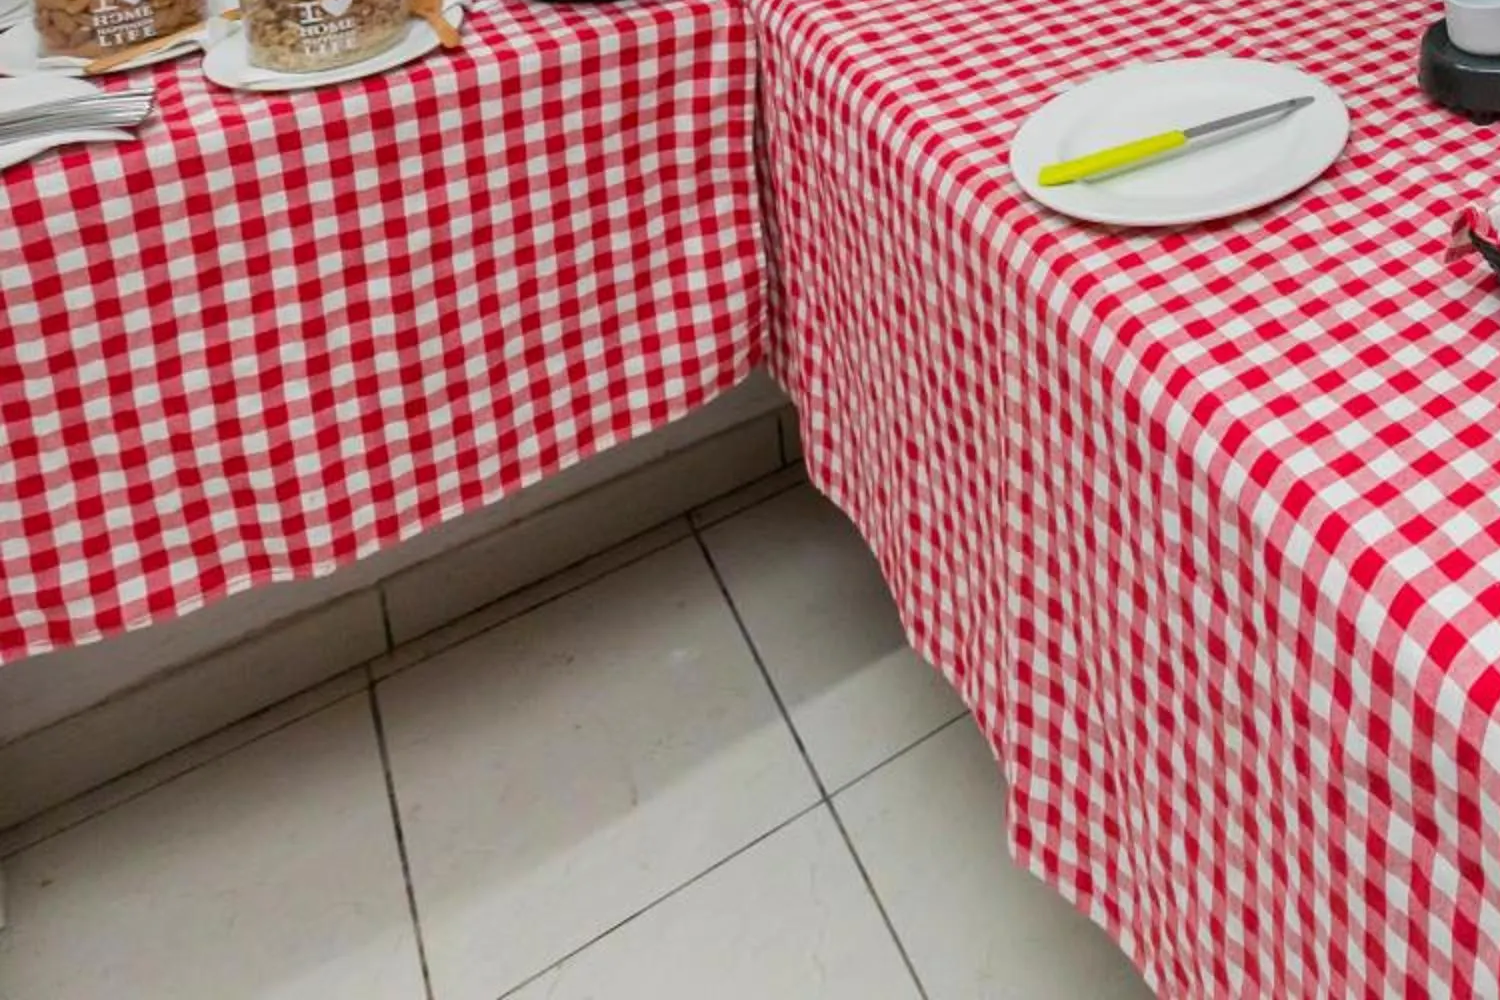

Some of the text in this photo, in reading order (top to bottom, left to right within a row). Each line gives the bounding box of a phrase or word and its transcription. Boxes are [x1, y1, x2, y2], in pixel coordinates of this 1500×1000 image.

[92, 4, 156, 27] HOME
[98, 27, 158, 48] LIFE
[298, 17, 356, 37] HOME
